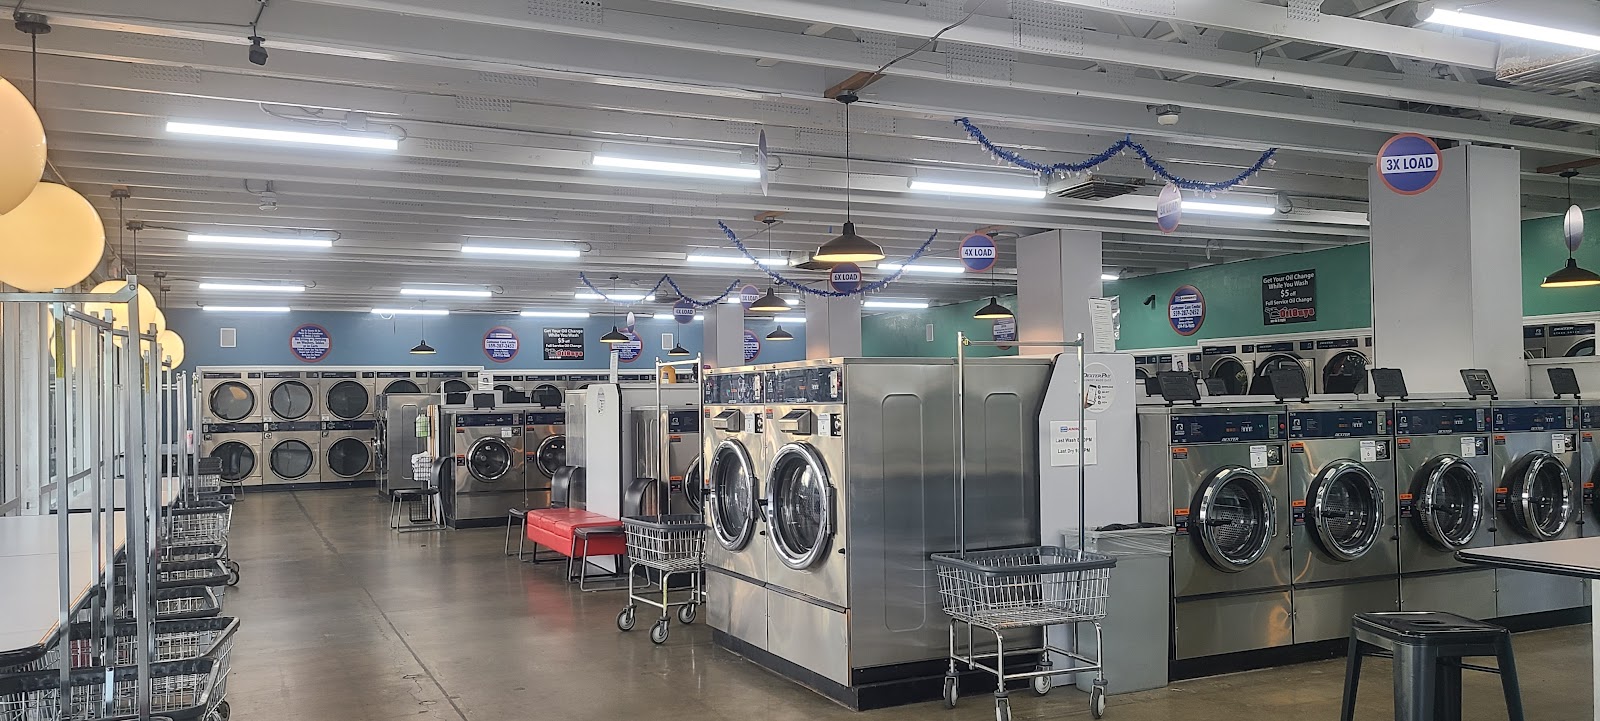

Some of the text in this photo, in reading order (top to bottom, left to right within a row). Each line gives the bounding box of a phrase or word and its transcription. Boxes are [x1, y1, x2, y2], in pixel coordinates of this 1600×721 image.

[1386, 156, 1433, 171] 3X LOAD
[964, 248, 993, 257] 4X LOAD
[842, 273, 858, 281] LOAD
[1273, 275, 1285, 283] Your
[1293, 272, 1315, 281] Change
[1293, 279, 1309, 287] Wash
[1280, 289, 1290, 298] $5
[1273, 298, 1289, 306] Service
[1295, 296, 1313, 304] Change
